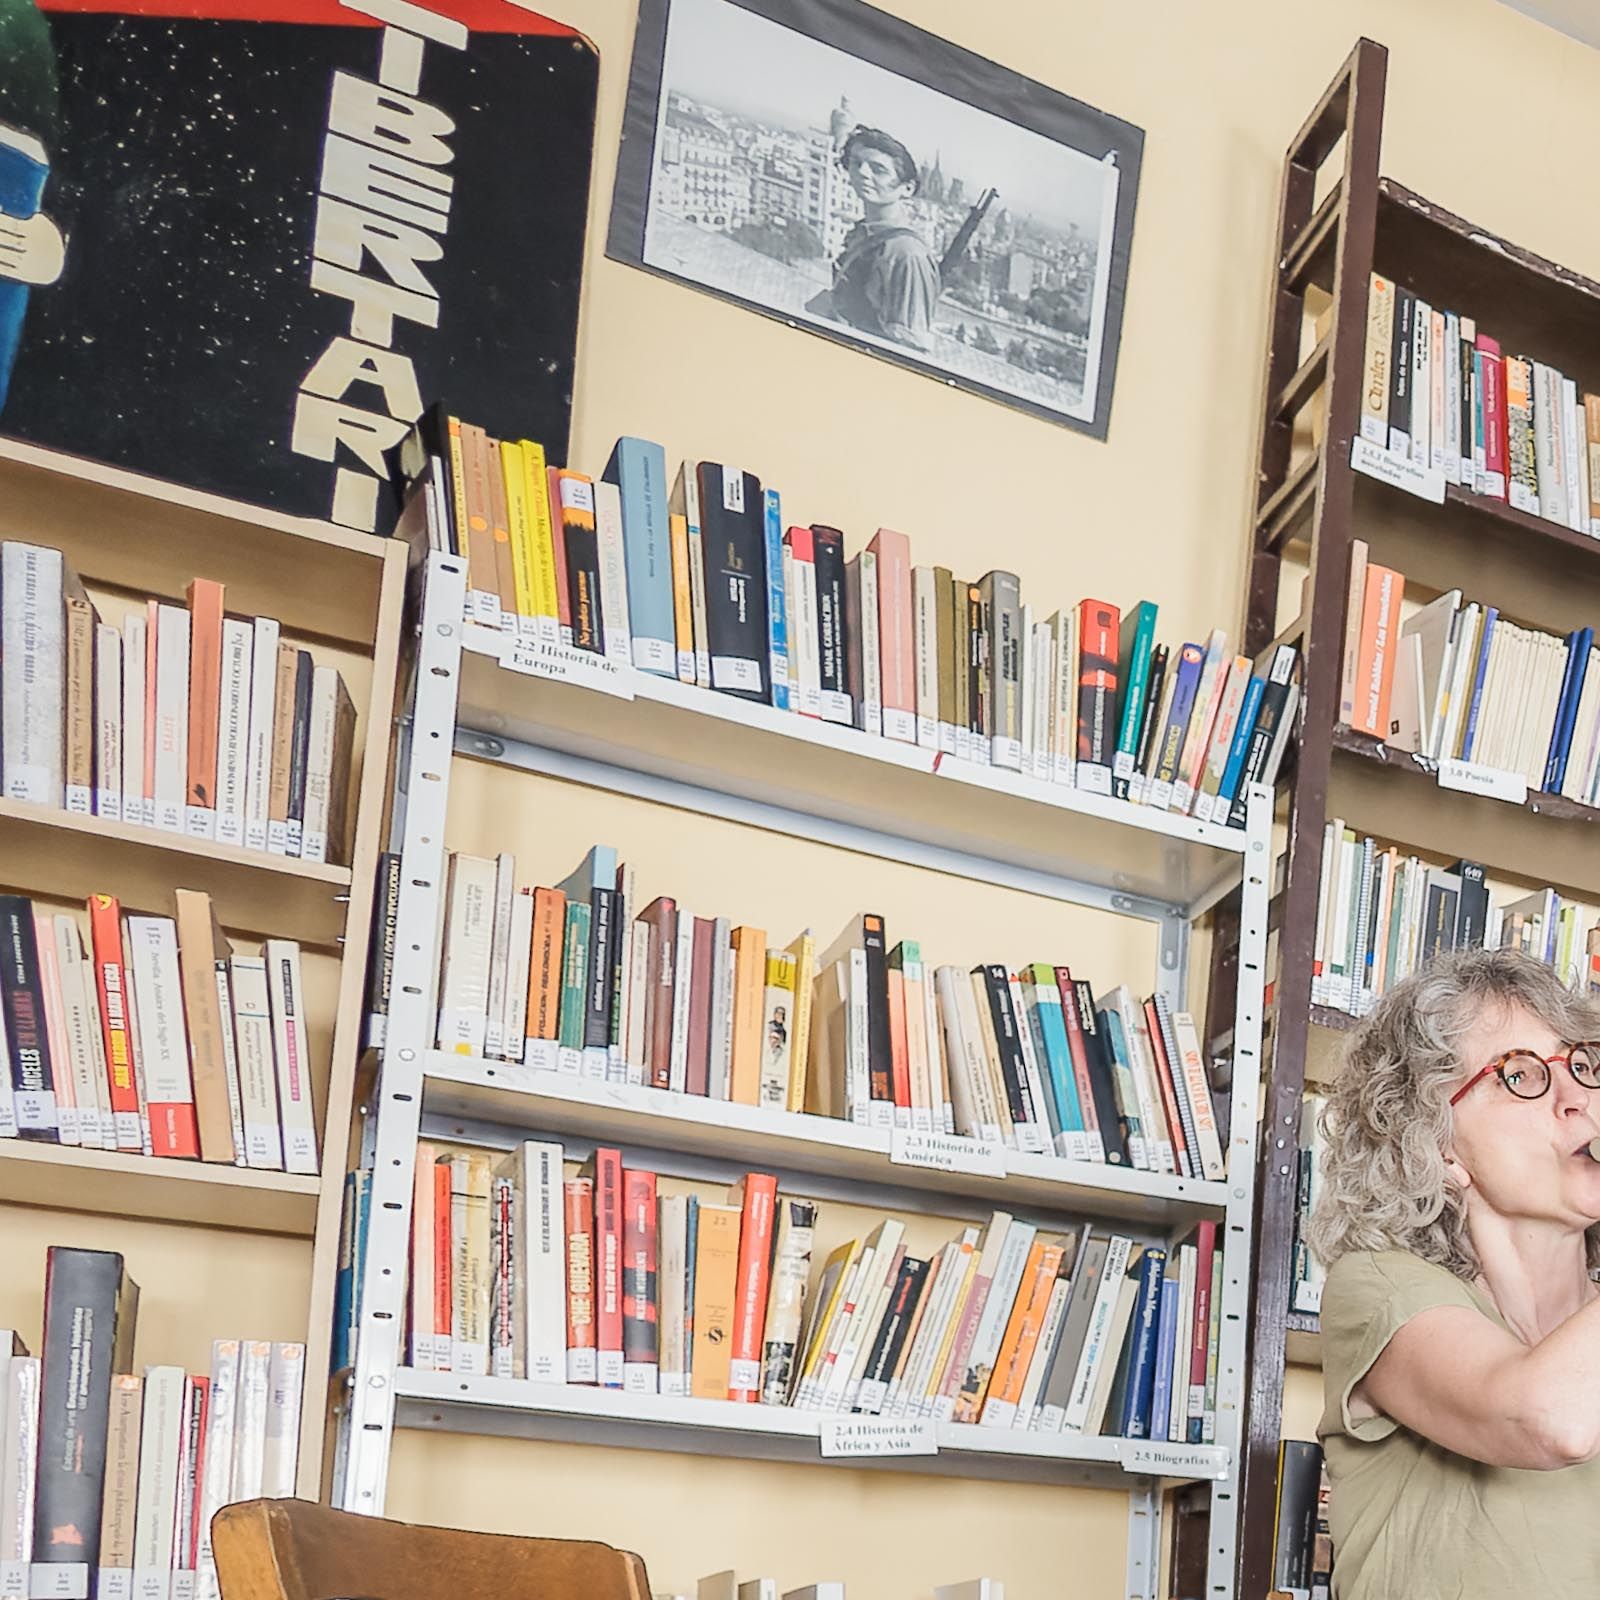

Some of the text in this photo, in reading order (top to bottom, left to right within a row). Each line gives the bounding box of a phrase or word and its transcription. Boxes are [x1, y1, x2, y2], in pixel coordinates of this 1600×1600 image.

[292, 0, 469, 533] IBERTARI
[511, 652, 568, 678] Europa
[514, 637, 619, 676] 2.2 Historia de
[906, 1136, 923, 1148] 2.3
[925, 1138, 975, 1155] Historia
[901, 1150, 952, 1166] América
[570, 1232, 591, 1325] CHE GUEVARA
[836, 1425, 854, 1436] 2.4
[857, 1424, 907, 1436] Historia
[883, 1438, 911, 1450] Asia
